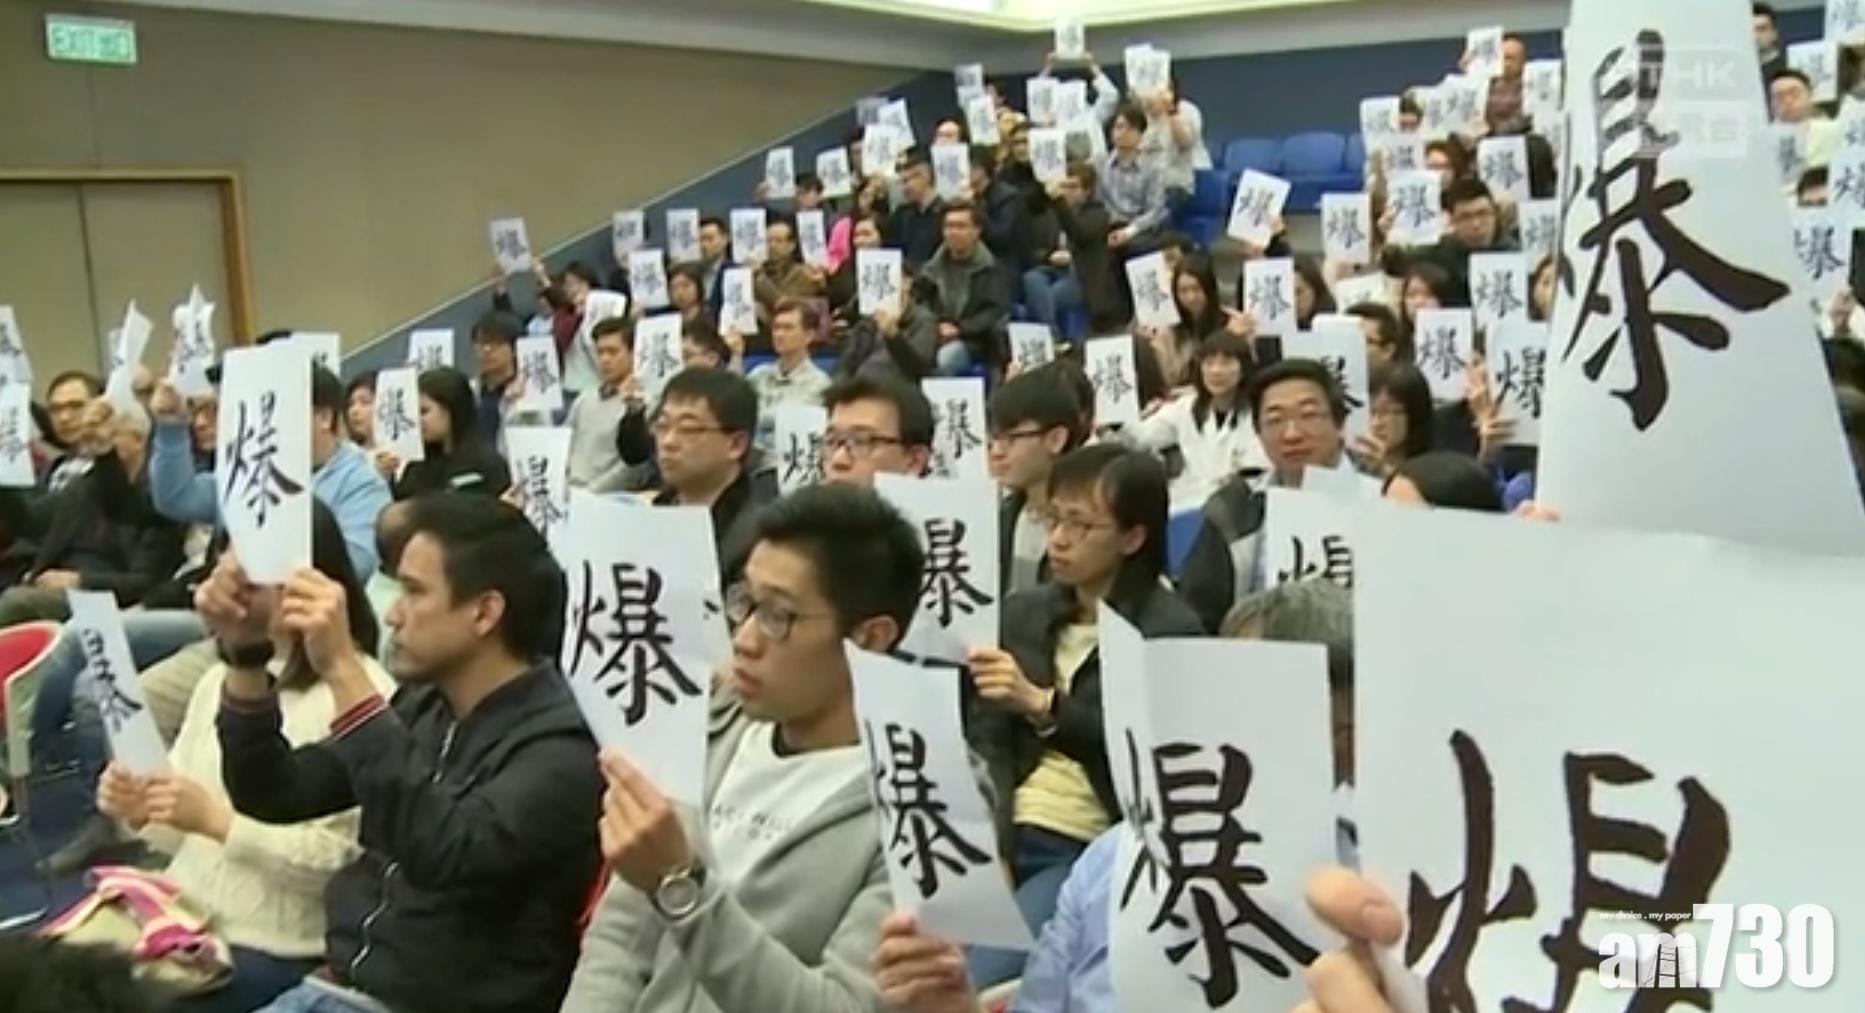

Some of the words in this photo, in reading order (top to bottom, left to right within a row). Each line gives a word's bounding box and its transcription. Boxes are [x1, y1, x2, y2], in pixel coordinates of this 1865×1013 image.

[570, 560, 702, 727] 爆
[866, 719, 993, 899] 爆
[1120, 727, 1320, 1010] 爆
